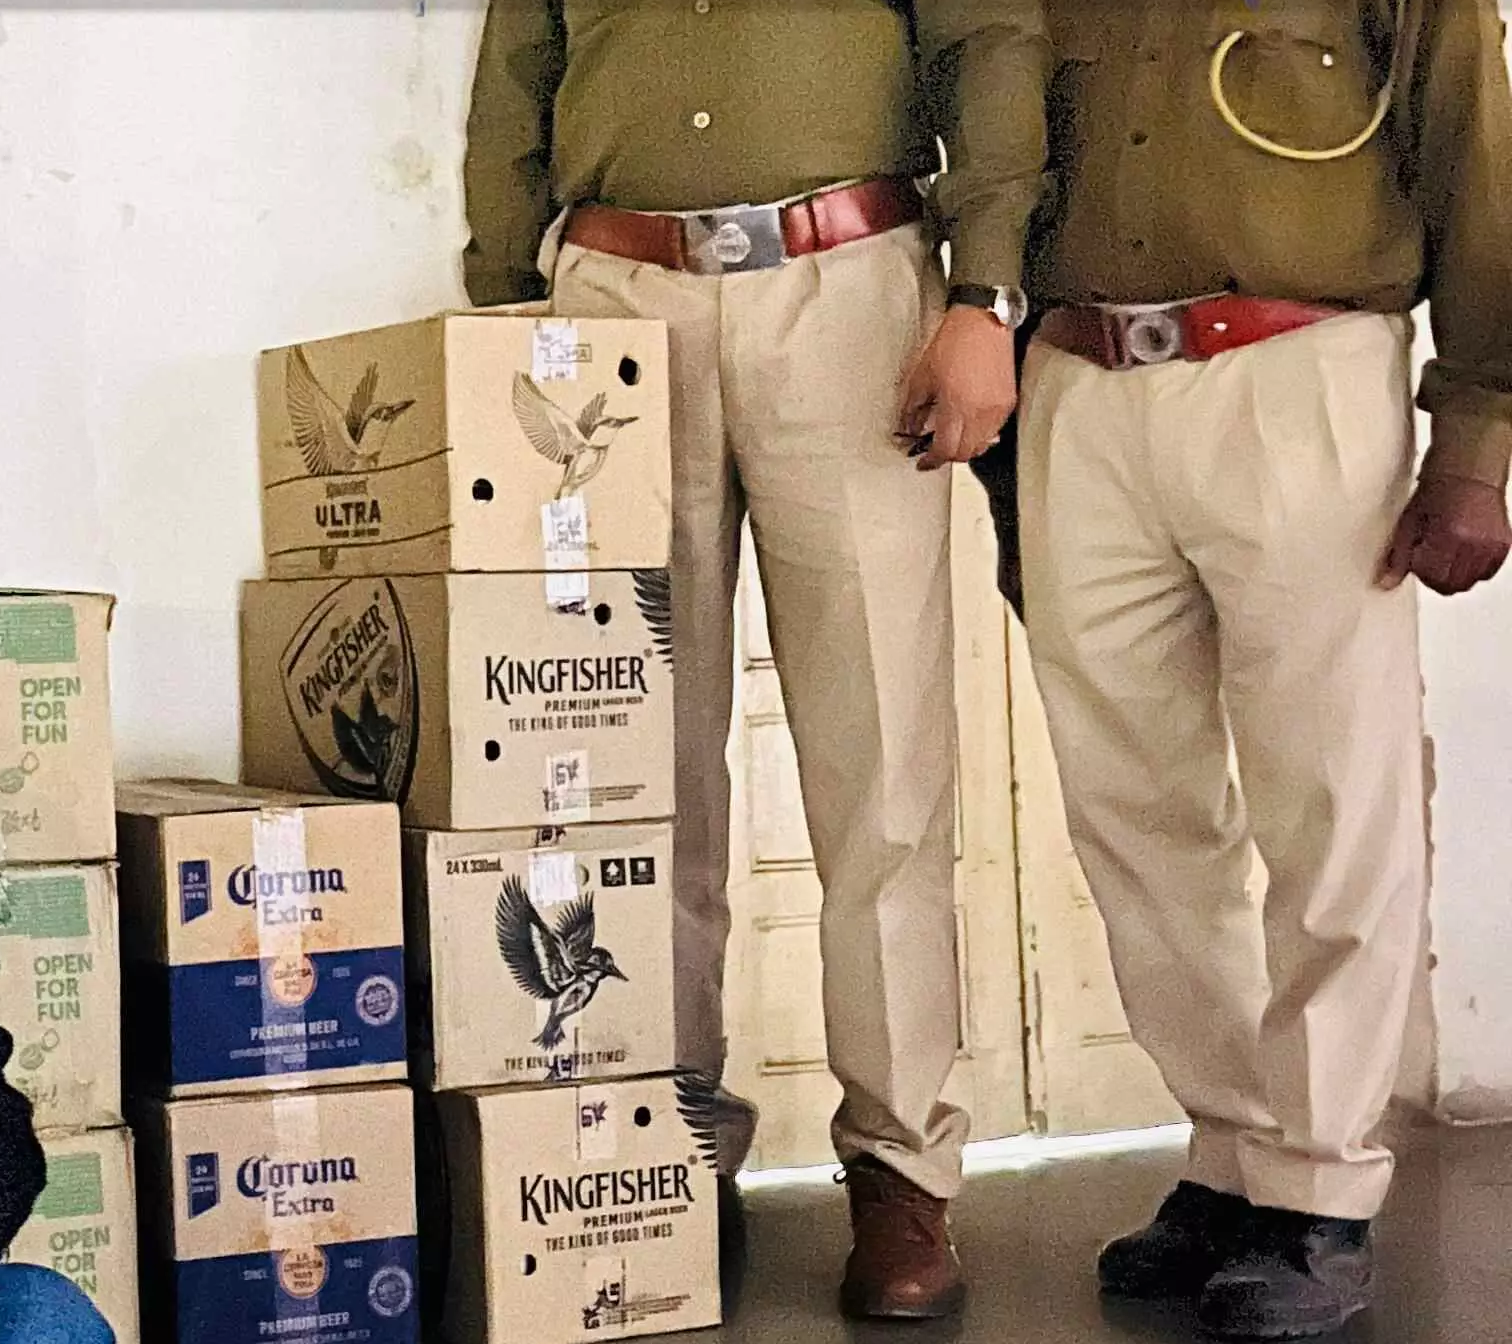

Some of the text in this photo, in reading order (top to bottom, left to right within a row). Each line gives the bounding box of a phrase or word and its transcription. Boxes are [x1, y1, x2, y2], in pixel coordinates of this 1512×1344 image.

[316, 499, 382, 527] ULTRA
[19, 676, 81, 698] OPEN
[484, 655, 650, 706] KINGFISHER
[21, 701, 67, 721] FOR
[544, 698, 601, 712] PREMIUM
[22, 724, 68, 744] FUN
[508, 717, 526, 732] THE
[557, 715, 568, 730] OF
[600, 713, 629, 728] TIMES
[227, 864, 348, 909] Corona
[263, 900, 324, 925] Extra
[33, 953, 93, 976] OPEN
[35, 977, 80, 1000] FOR
[37, 1001, 82, 1022] FUN
[237, 1155, 361, 1202] Corona
[272, 1191, 335, 1217] Extra
[520, 1164, 695, 1226] KINGFISHER
[583, 1210, 644, 1228] PREMIUM
[48, 1225, 111, 1252] OPEN
[545, 1222, 673, 1252] THE KING OF GOOD TIMES
[52, 1253, 97, 1273] FOR
